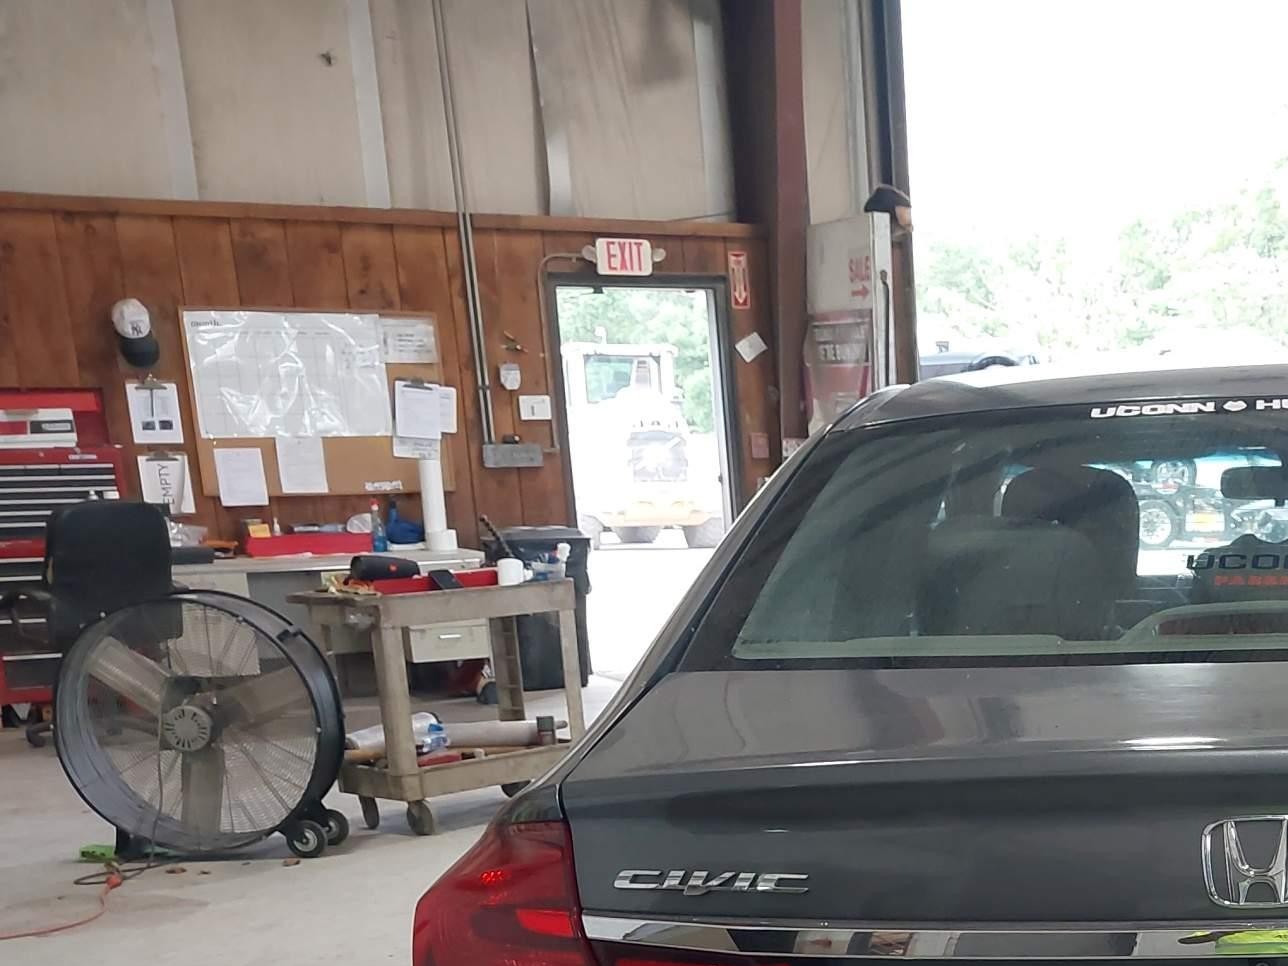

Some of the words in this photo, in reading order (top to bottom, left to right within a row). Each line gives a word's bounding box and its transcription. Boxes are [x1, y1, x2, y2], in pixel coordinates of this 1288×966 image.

[606, 241, 643, 271] EXIT
[1090, 402, 1216, 418] UCONN
[158, 463, 176, 505] EMPTY
[613, 869, 809, 896] CIVIC
